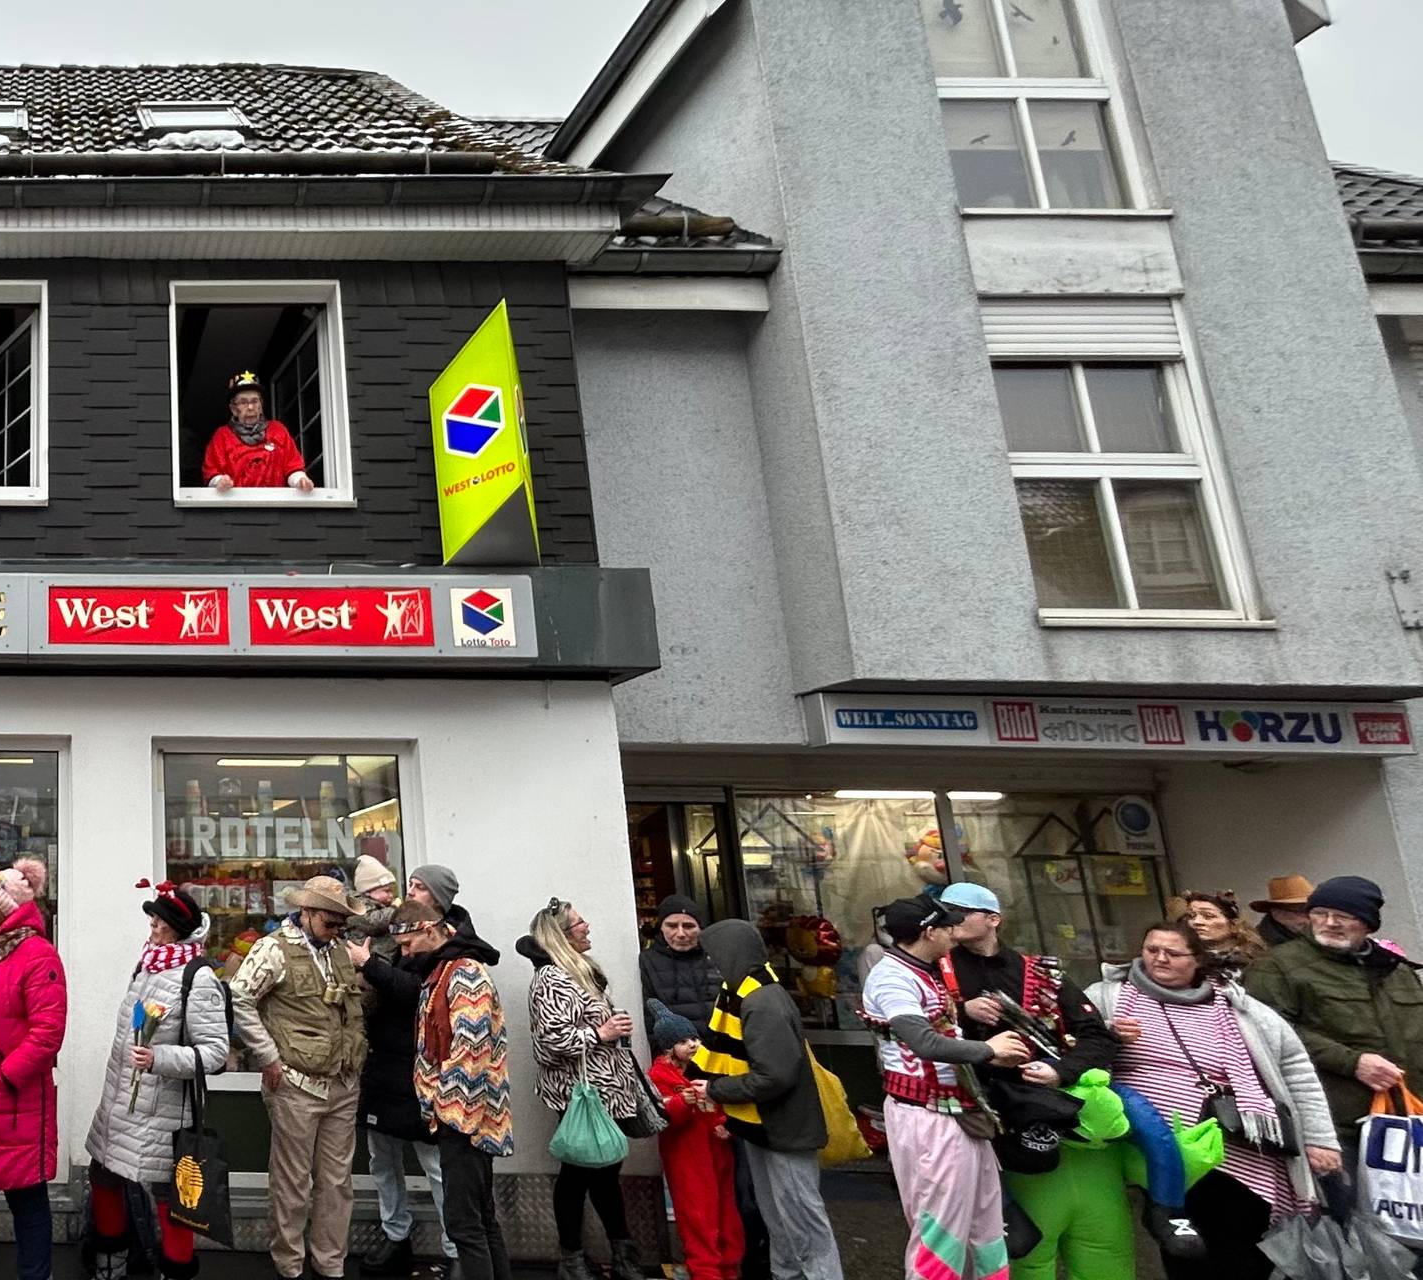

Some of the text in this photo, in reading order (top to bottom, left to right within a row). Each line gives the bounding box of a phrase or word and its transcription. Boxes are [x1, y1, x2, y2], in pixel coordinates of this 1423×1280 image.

[444, 462, 515, 496] WEST LOTTO
[55, 597, 151, 630] West
[255, 597, 353, 631] West
[460, 638, 511, 648] Lotto Toto
[838, 711, 888, 727] WELT
[894, 711, 975, 729] SONNTAG
[996, 704, 1037, 740] Bild
[1139, 707, 1183, 743] Bild
[1375, 1199, 1423, 1222] ACTI
